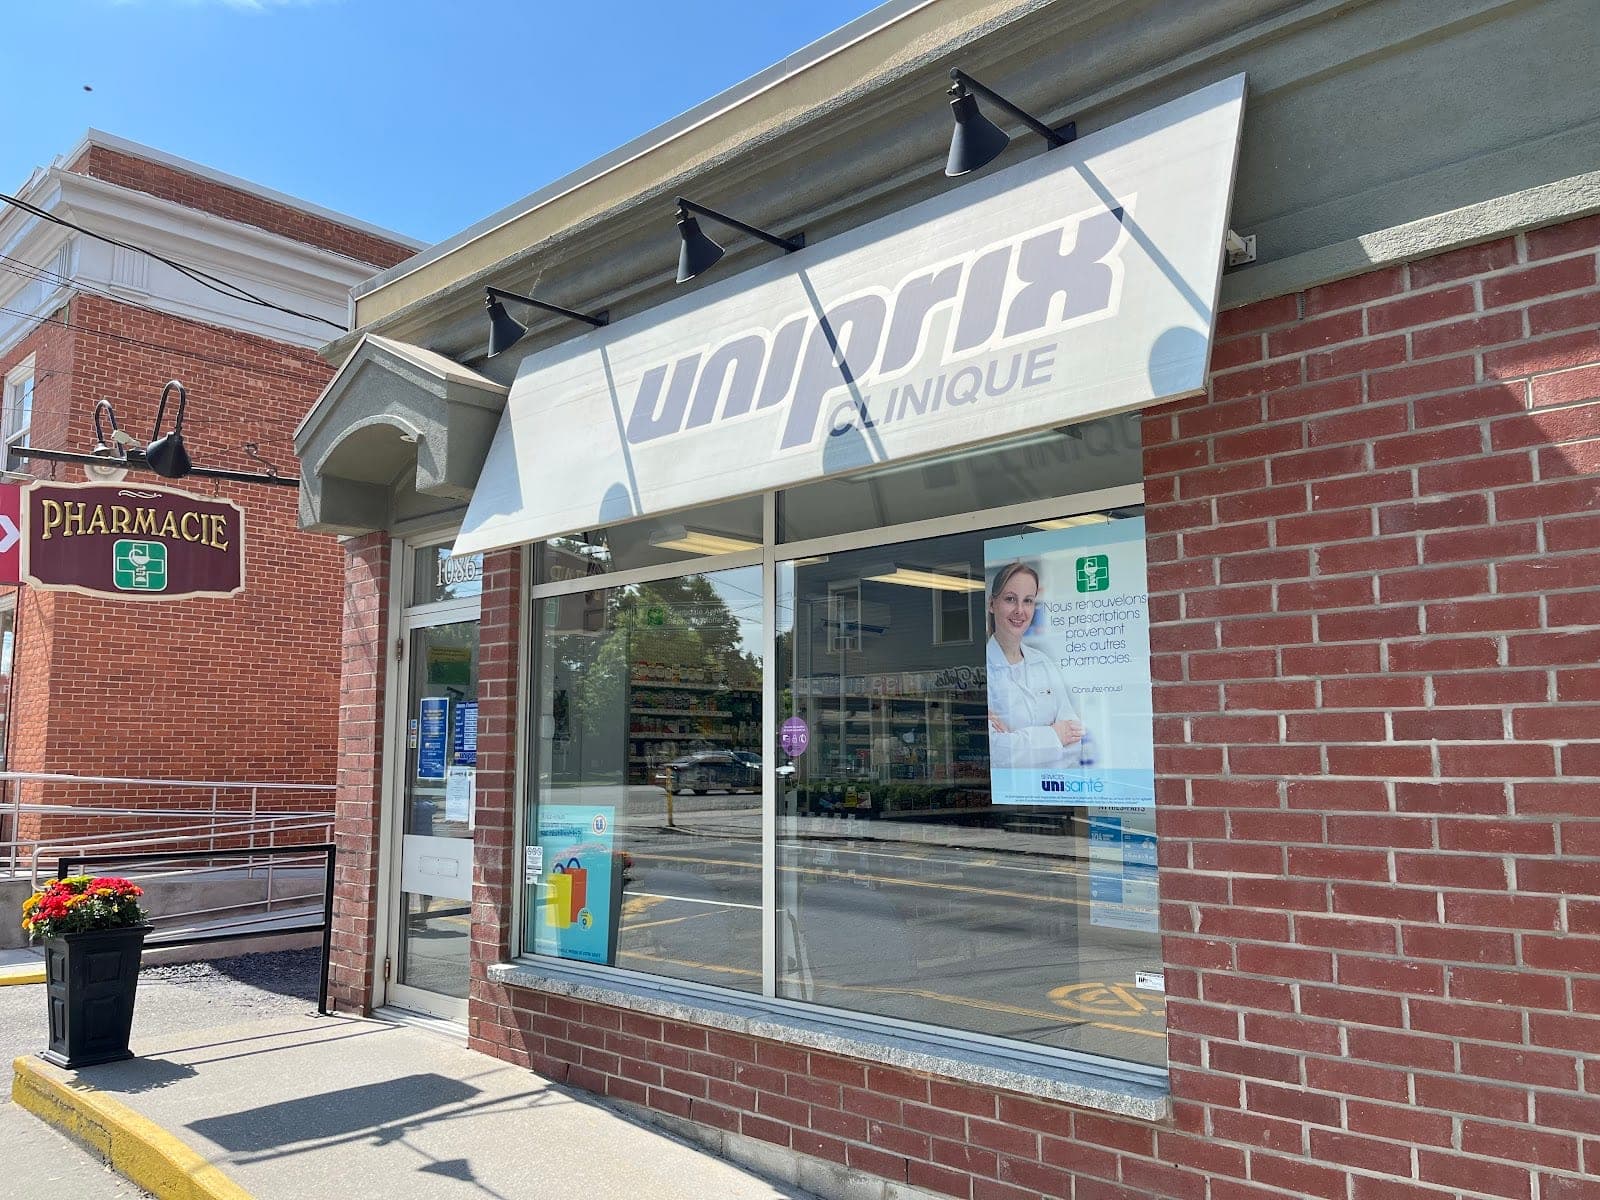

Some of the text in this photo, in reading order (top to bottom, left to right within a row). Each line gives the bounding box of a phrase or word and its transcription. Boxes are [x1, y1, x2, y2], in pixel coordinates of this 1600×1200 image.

[626, 205, 1124, 451] uniprix
[828, 343, 1058, 437] CLINIQUE
[42, 499, 229, 552] PHARMACIE
[436, 554, 476, 587] 1086
[1043, 593, 1147, 614] Nous renouvelons
[1050, 608, 1141, 626] les prescriptions
[1065, 624, 1125, 642] provenant
[1065, 638, 1126, 653] des autres
[1041, 776, 1104, 793] unisanté
